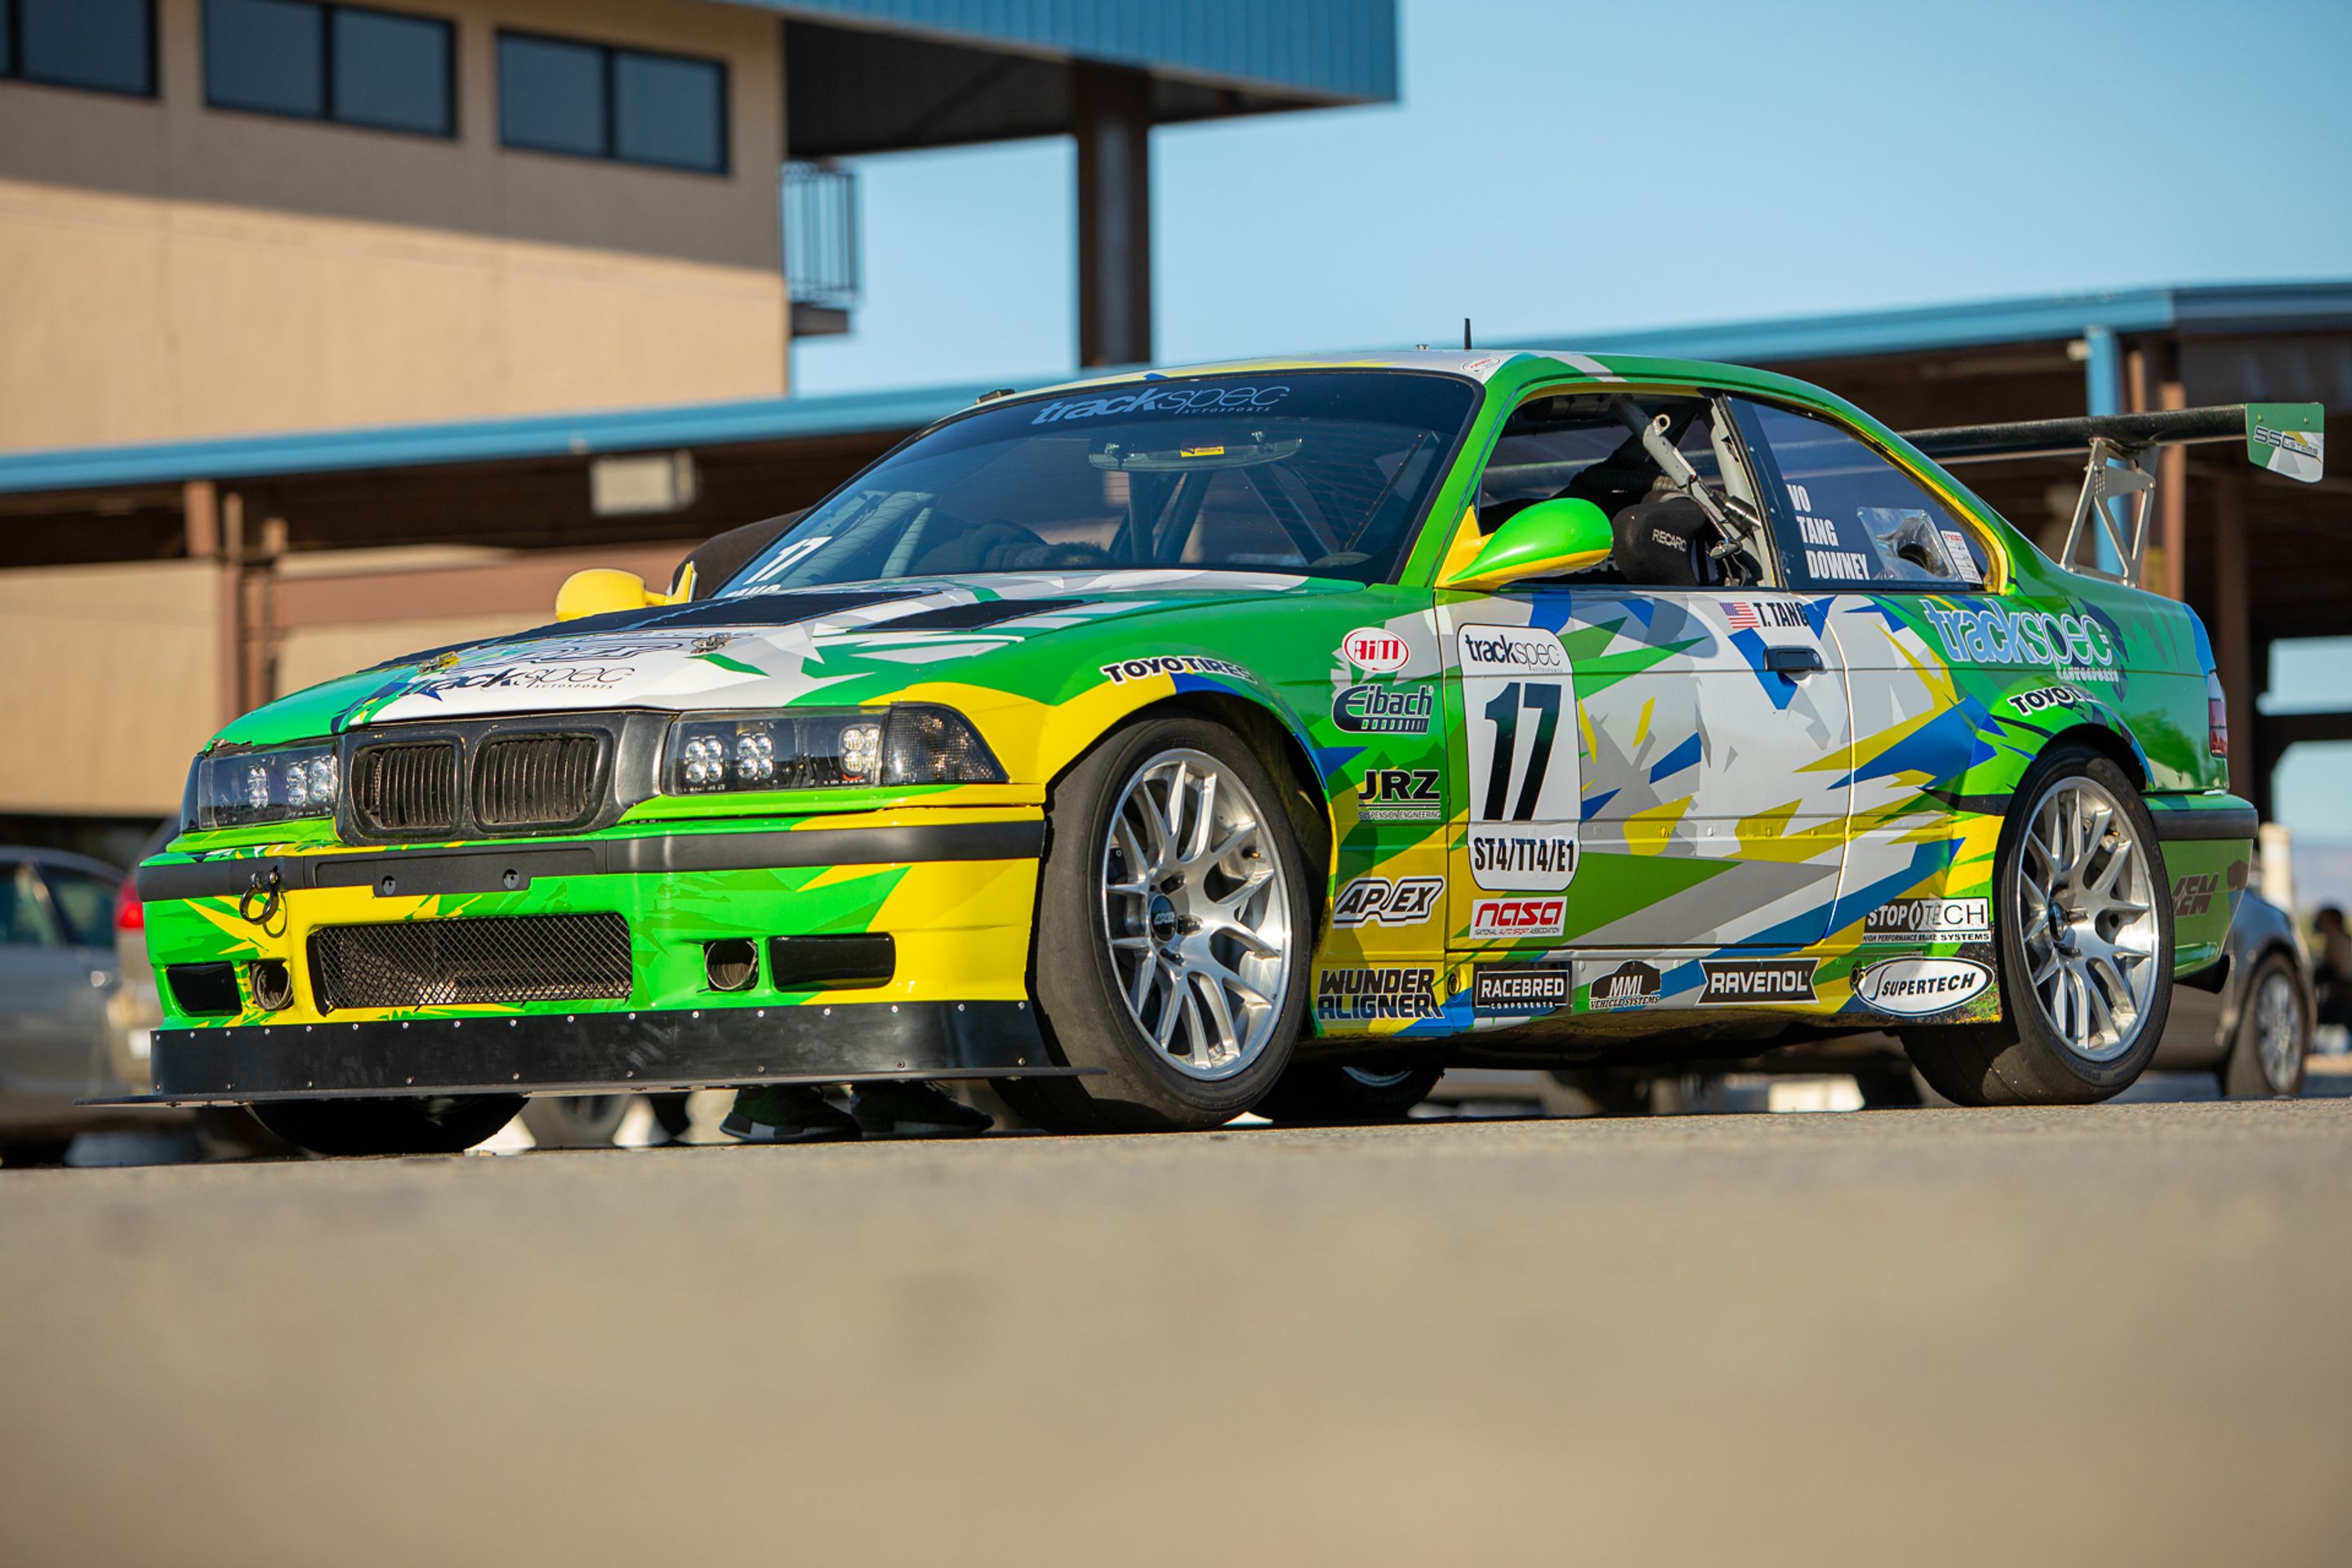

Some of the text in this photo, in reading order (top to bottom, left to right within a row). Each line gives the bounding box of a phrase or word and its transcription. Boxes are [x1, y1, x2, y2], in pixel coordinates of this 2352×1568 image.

[1031, 385, 1290, 425] trackspec
[1786, 484, 1811, 512] VO
[1651, 528, 1686, 552] RECARO
[1796, 515, 1839, 546] TANG
[1806, 550, 1870, 580] DOWNEY
[1766, 602, 1811, 627] TANG
[1919, 598, 2114, 678] trackspec
[1465, 634, 1561, 670] trackspec
[1100, 657, 1184, 684] TOYO
[1333, 684, 1433, 733] Eibach
[2009, 688, 2071, 715] TOYO
[1484, 682, 1561, 821] 17
[1358, 769, 1441, 801] JRZ
[1400, 809, 1441, 819] ENGINEERING
[1473, 836, 1574, 871] ST4/TT4/E1
[1918, 933, 1938, 942] BRAKE
[1940, 933, 1989, 941] SYSTEMS
[1319, 968, 1436, 995] WUNDER
[1481, 978, 1565, 999] RACEBRED
[1710, 969, 1809, 994] RAVENOL
[1881, 973, 1977, 997] SUPERTECH
[1317, 994, 1444, 1020] ALIGNER
[1490, 1001, 1554, 1010] COMPONENTS
[1591, 996, 1660, 1009] VEHICLE SYSTEMS
